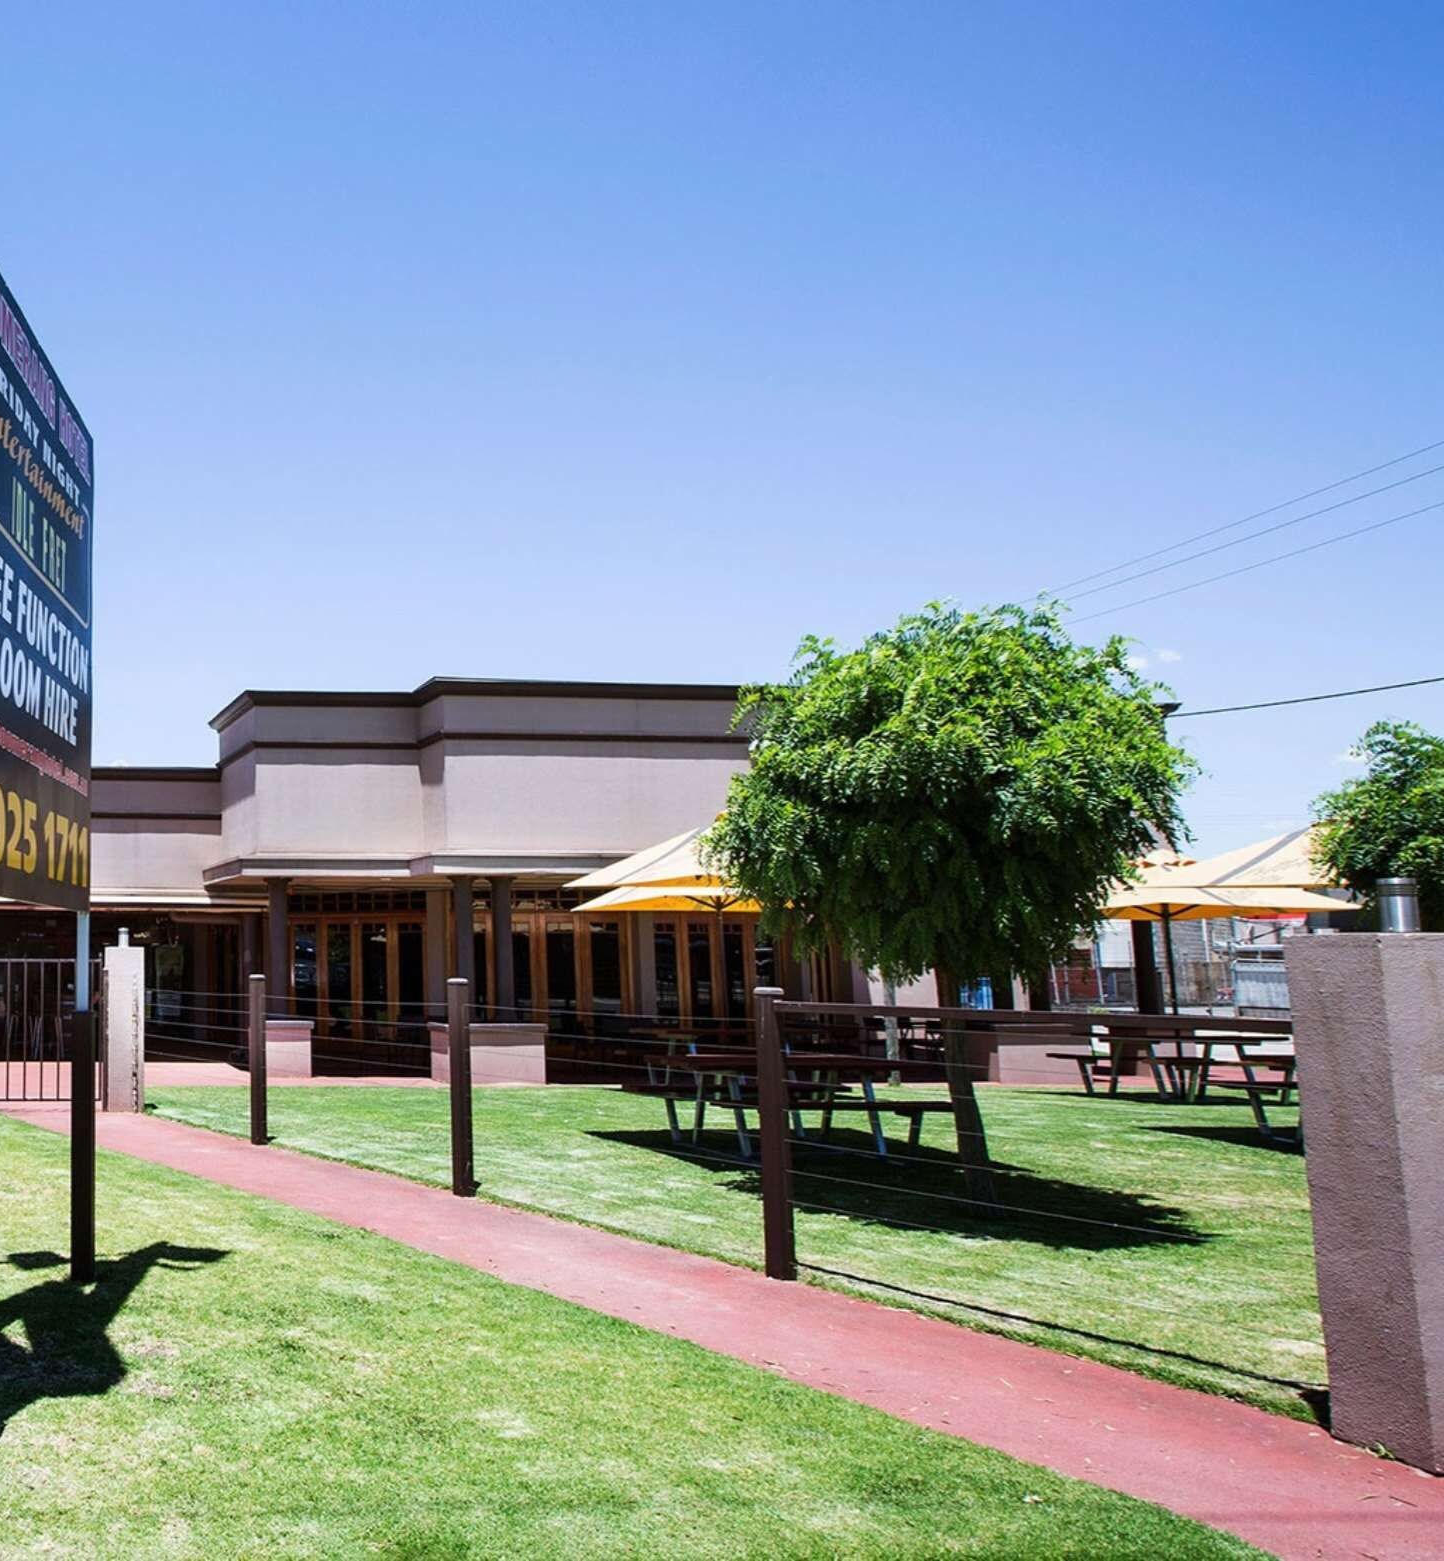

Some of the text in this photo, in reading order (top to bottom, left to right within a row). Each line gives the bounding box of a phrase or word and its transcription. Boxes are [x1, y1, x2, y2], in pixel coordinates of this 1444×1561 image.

[42, 438, 81, 508] NIGHT
[59, 397, 92, 488] HOTEL
[11, 476, 67, 594] IDLE FRET
[17, 578, 89, 694] FUNCTION
[44, 678, 78, 746] HIRE
[43, 811, 89, 888] 1711
